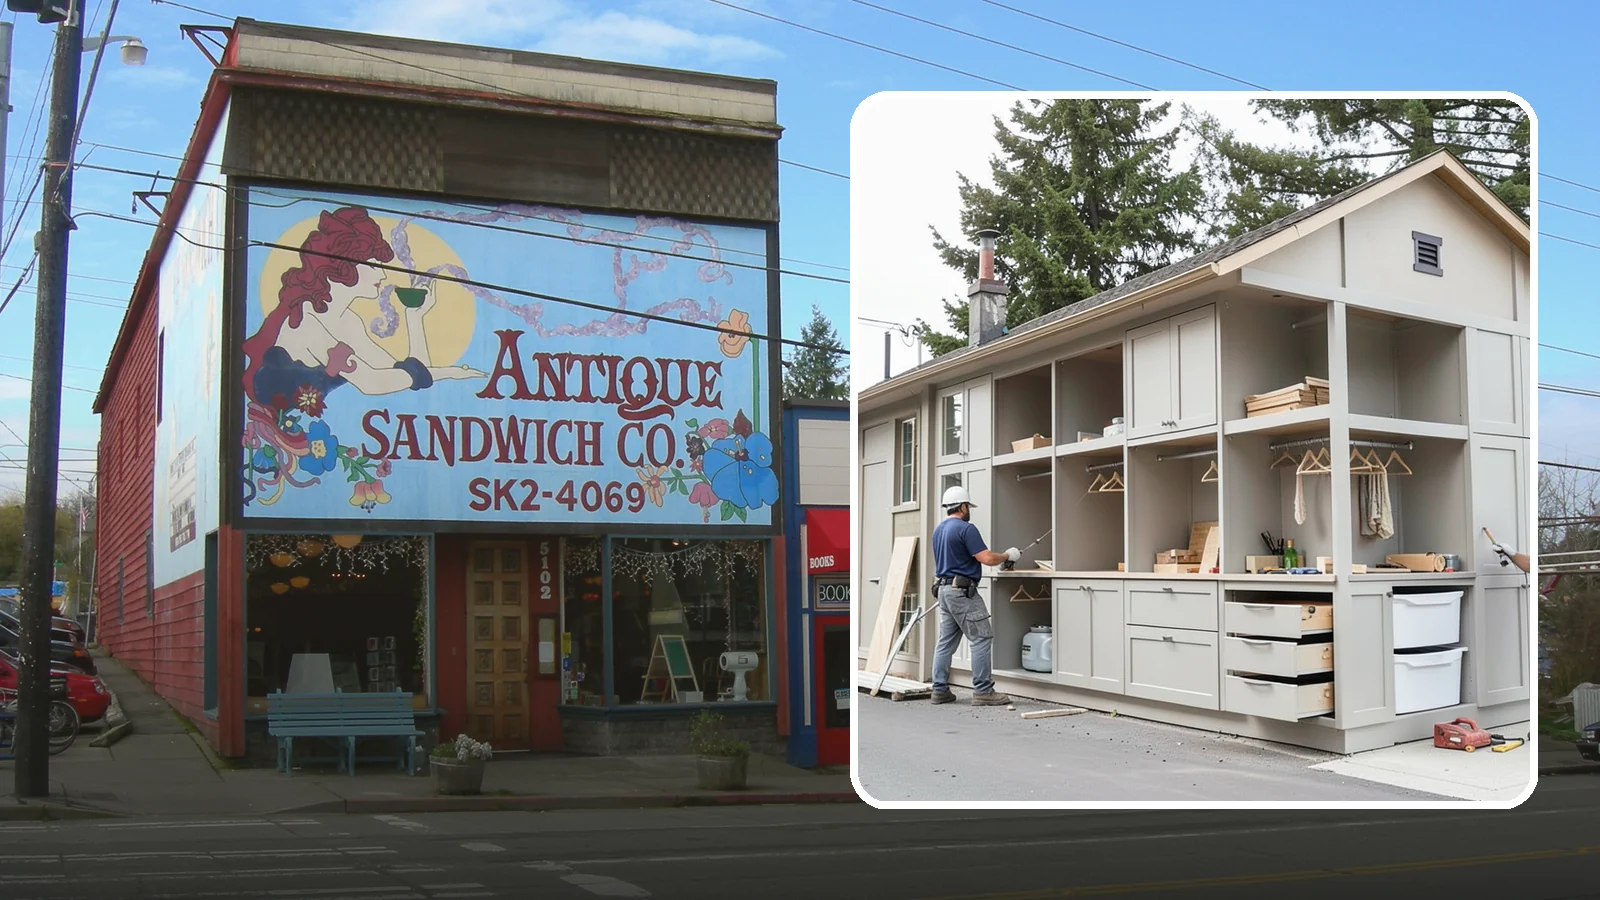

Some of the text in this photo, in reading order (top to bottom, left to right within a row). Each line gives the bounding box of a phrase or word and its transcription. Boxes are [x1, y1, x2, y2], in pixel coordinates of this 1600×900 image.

[476, 329, 723, 421] ANTIQUE
[361, 409, 685, 469] SANDWICH CO.
[468, 477, 646, 514] SK2-4069
[540, 541, 552, 600] 5102
[809, 555, 835, 569] BOOKS
